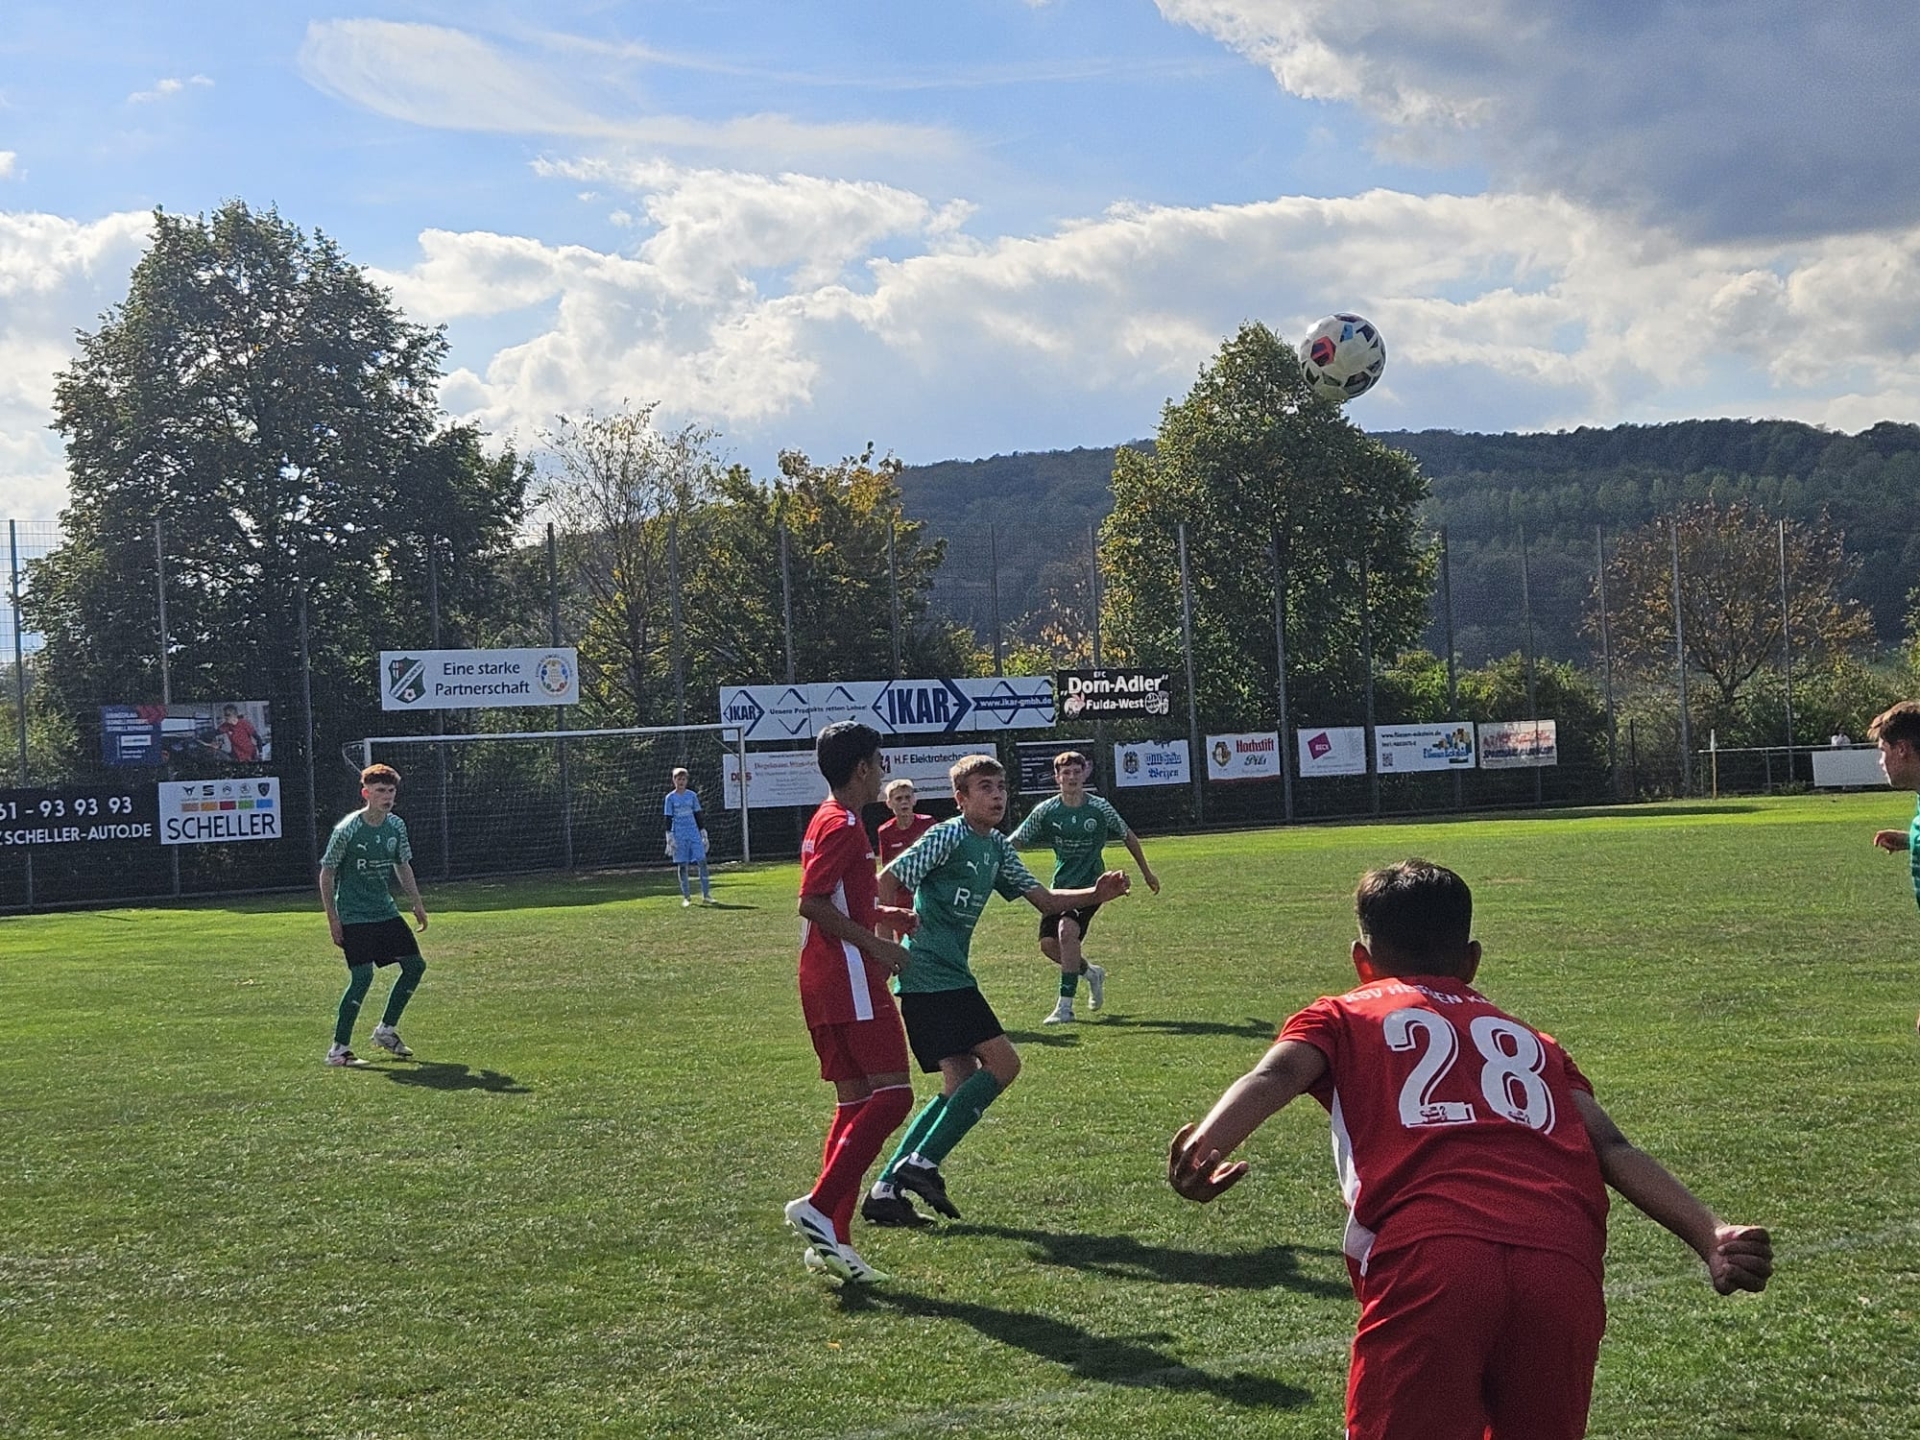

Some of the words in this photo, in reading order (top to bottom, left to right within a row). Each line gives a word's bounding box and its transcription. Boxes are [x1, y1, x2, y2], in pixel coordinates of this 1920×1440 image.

[443, 663, 474, 675] Eine
[478, 661, 520, 675] starke
[435, 680, 530, 696] Partnerschaft
[888, 688, 951, 724] IKAR
[980, 697, 1053, 708] www.ikar-gmbh.de
[1085, 698, 1144, 710] Fulda-West
[729, 705, 757, 721] IKAR
[1236, 738, 1275, 753] Hochstift
[39, 799, 66, 818] 93
[74, 797, 99, 816] 93
[108, 796, 133, 814] 93
[0, 823, 152, 845] .SCHELLER-AUTO.DE
[167, 813, 276, 840] SCHELLER
[356, 858, 367, 870] R
[954, 886, 971, 908] R
[1344, 987, 1383, 1003] KSV
[1382, 1007, 1556, 1135] 28
